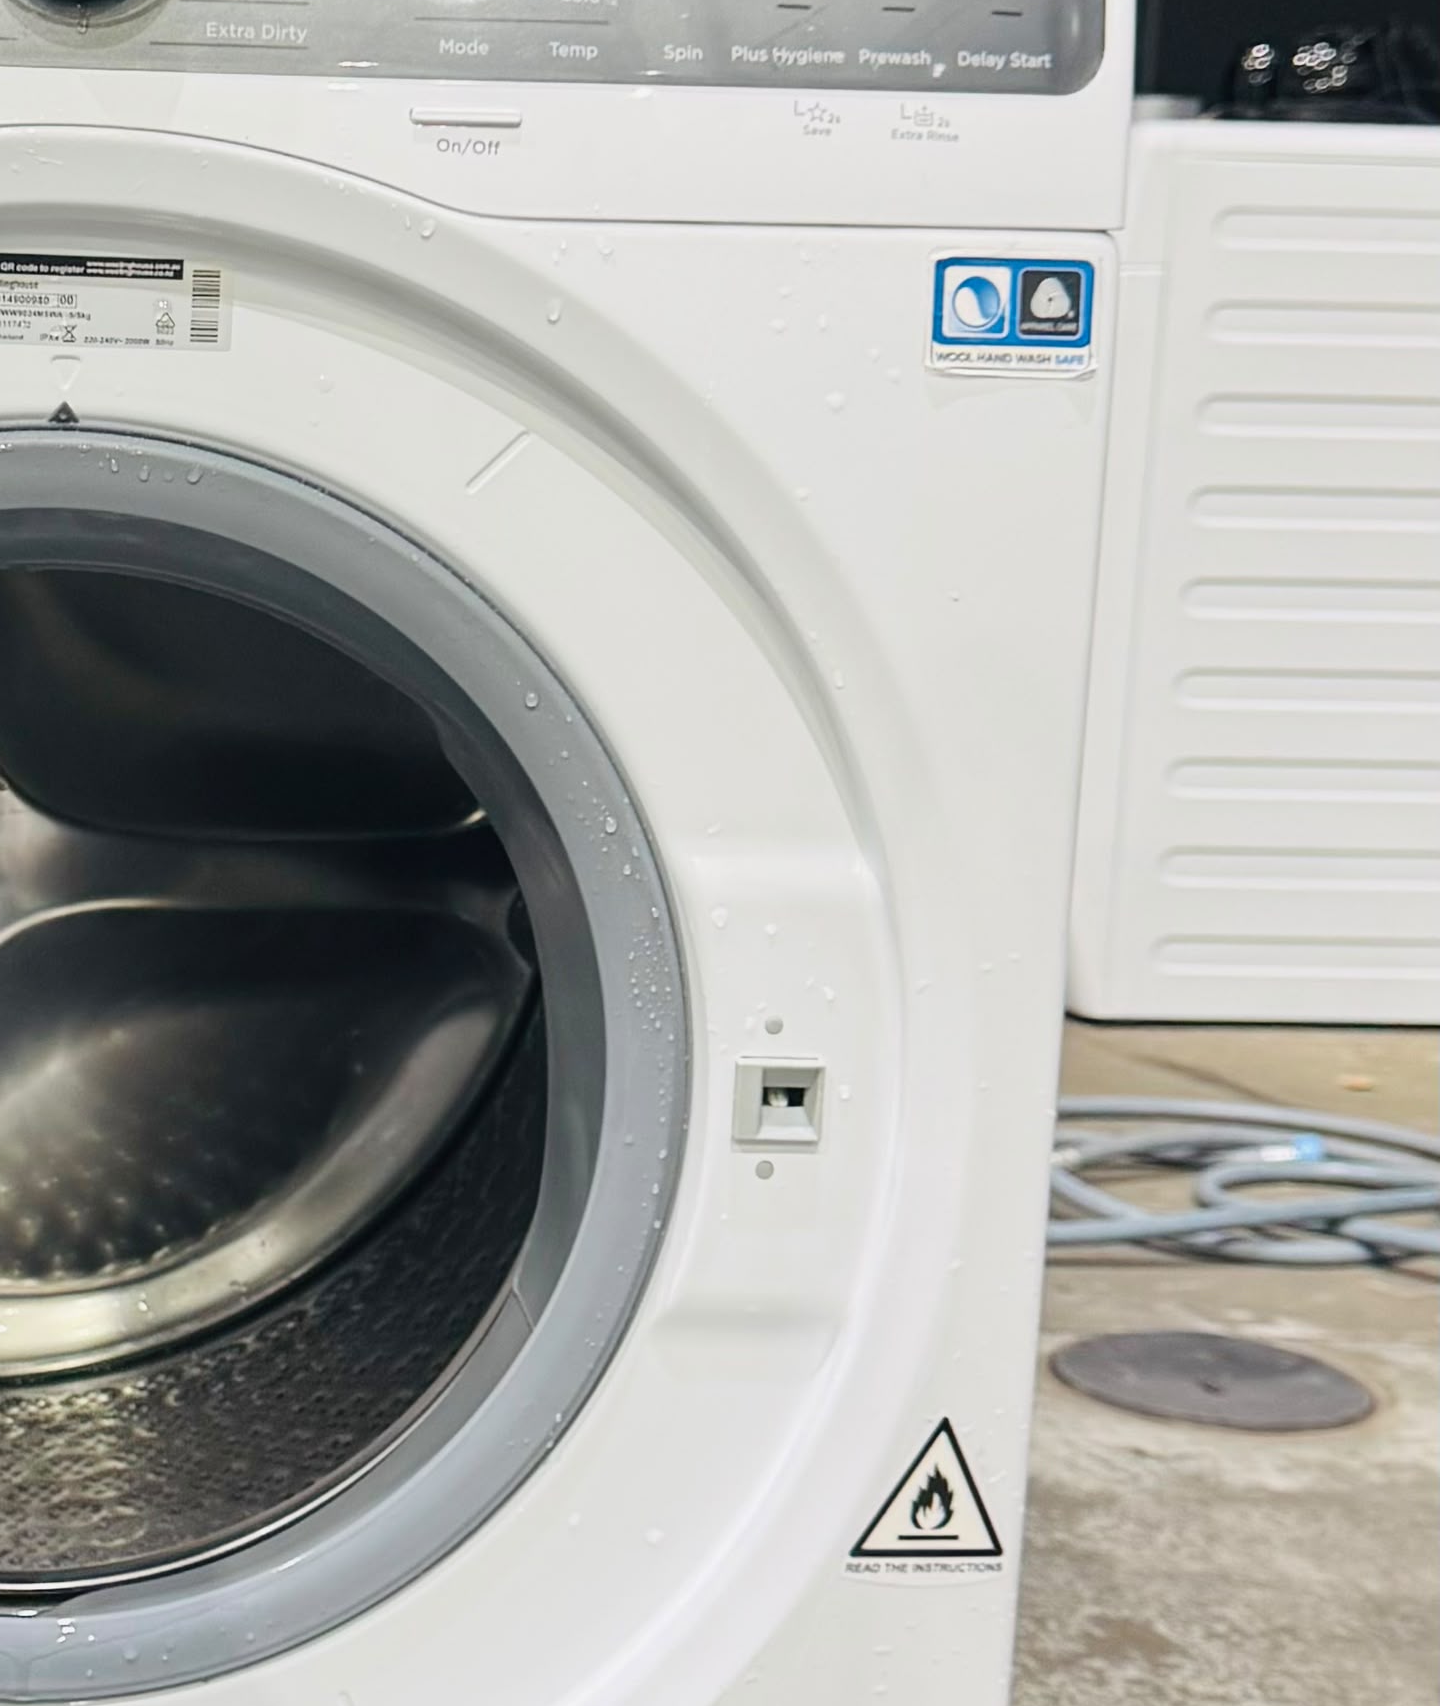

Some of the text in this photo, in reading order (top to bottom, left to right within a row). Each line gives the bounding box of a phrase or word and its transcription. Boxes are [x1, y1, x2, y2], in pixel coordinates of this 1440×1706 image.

[205, 21, 308, 43] Extra Dirty
[439, 38, 489, 55] Mode
[549, 41, 598, 61] Temp
[663, 44, 704, 62] Spin
[730, 45, 846, 68] Plus Hygiene
[858, 48, 932, 66] Prewash
[956, 50, 1053, 71] Delay Start
[802, 124, 832, 137] Save
[890, 129, 960, 143] Extra Rinse
[436, 137, 501, 157] On/Off
[0, 262, 16, 272] QR
[16, 263, 39, 272] code
[40, 263, 50, 273] to
[50, 264, 85, 275] register
[935, 351, 1086, 366] WOOL HAND WASH SAFE
[845, 1561, 1003, 1574] READ THE INSTRUCTIONS
